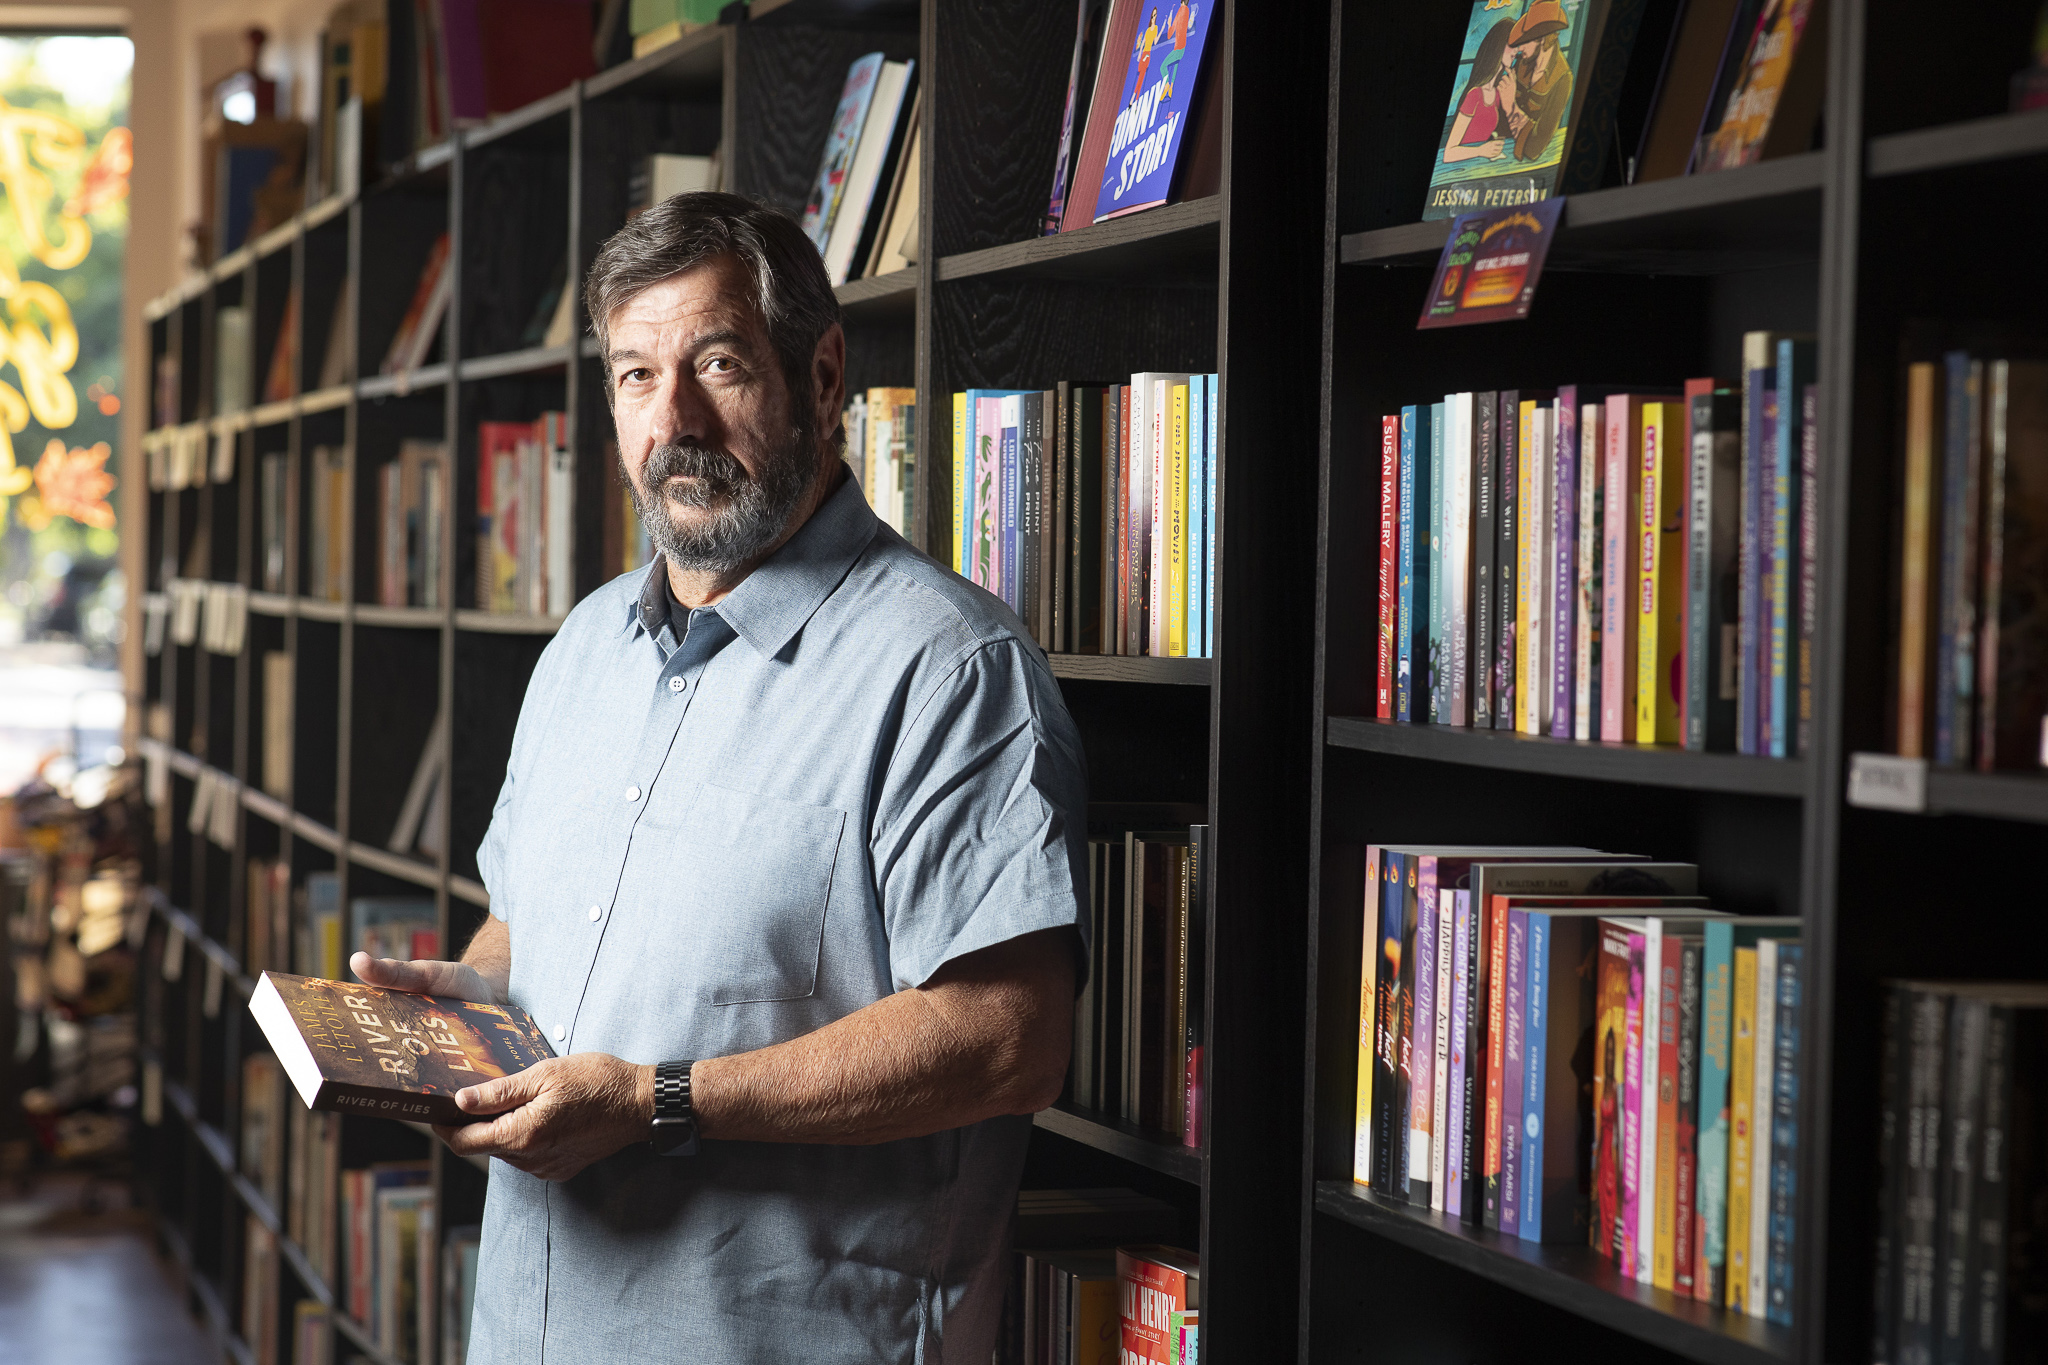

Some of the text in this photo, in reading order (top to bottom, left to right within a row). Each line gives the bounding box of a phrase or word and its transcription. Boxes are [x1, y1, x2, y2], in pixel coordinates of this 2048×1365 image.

[1114, 111, 1181, 201] STORY
[1431, 189, 1480, 207] JESSICA
[1111, 402, 1116, 413] IT
[1122, 420, 1126, 436] BE
[1023, 440, 1033, 486] Fine
[1033, 440, 1042, 486] Fine
[1192, 459, 1197, 480] ME
[1211, 459, 1216, 480] ME
[1383, 425, 1392, 475] SUSAN
[1482, 420, 1490, 473] WRONG
[1504, 419, 1512, 501] TEMPORARY
[1043, 461, 1051, 534] THROTTLED
[1434, 488, 1439, 501] Go
[1481, 476, 1489, 518] BRIDE
[1608, 461, 1619, 513] WHITE
[1697, 499, 1706, 521] ME
[1382, 481, 1391, 548] MALLERY
[1504, 505, 1512, 541] WIFE
[1644, 428, 1654, 613] LAST NIGHT WAS FUN
[1379, 558, 1391, 601] happily
[1607, 535, 1618, 586] ROYAL
[1606, 594, 1618, 634] BLUE
[1380, 623, 1392, 678] Christmas
[1191, 888, 1196, 904] OF
[1505, 879, 1569, 888] MILITARY FAKE
[1441, 919, 1452, 975] HAPPILY
[1469, 912, 1477, 957] MAYBE
[1416, 886, 1434, 1085] Beautiful Bad Man Ellen
[1455, 923, 1467, 1013] ACCIDENTALLY
[1363, 978, 1373, 1016] Austin
[1384, 981, 1396, 1031] Austin
[1402, 985, 1413, 1035] Austin
[294, 998, 338, 1051] JAMES
[318, 994, 364, 1063] L'ETOILE
[342, 995, 410, 1076] RIVER
[392, 1021, 431, 1057] OF
[424, 1016, 475, 1073] LIES
[1361, 1017, 1369, 1050] heat
[1437, 1011, 1447, 1062] AFTER
[1453, 1013, 1464, 1054] AMY
[503, 1036, 520, 1060] NOVEL
[1382, 1031, 1394, 1073] heat
[1400, 1036, 1412, 1079] heat
[1505, 922, 1523, 1202] Failure to Match KYRA PARSI
[336, 1095, 431, 1115] RIVER OF LIES
[1465, 1076, 1473, 1129] WESTON
[1450, 1107, 1458, 1166] PAINTER
[1463, 1134, 1472, 1181] PARKER
[1140, 1285, 1177, 1333] HENRY
[1135, 1326, 1161, 1340] FUNNY STORY
